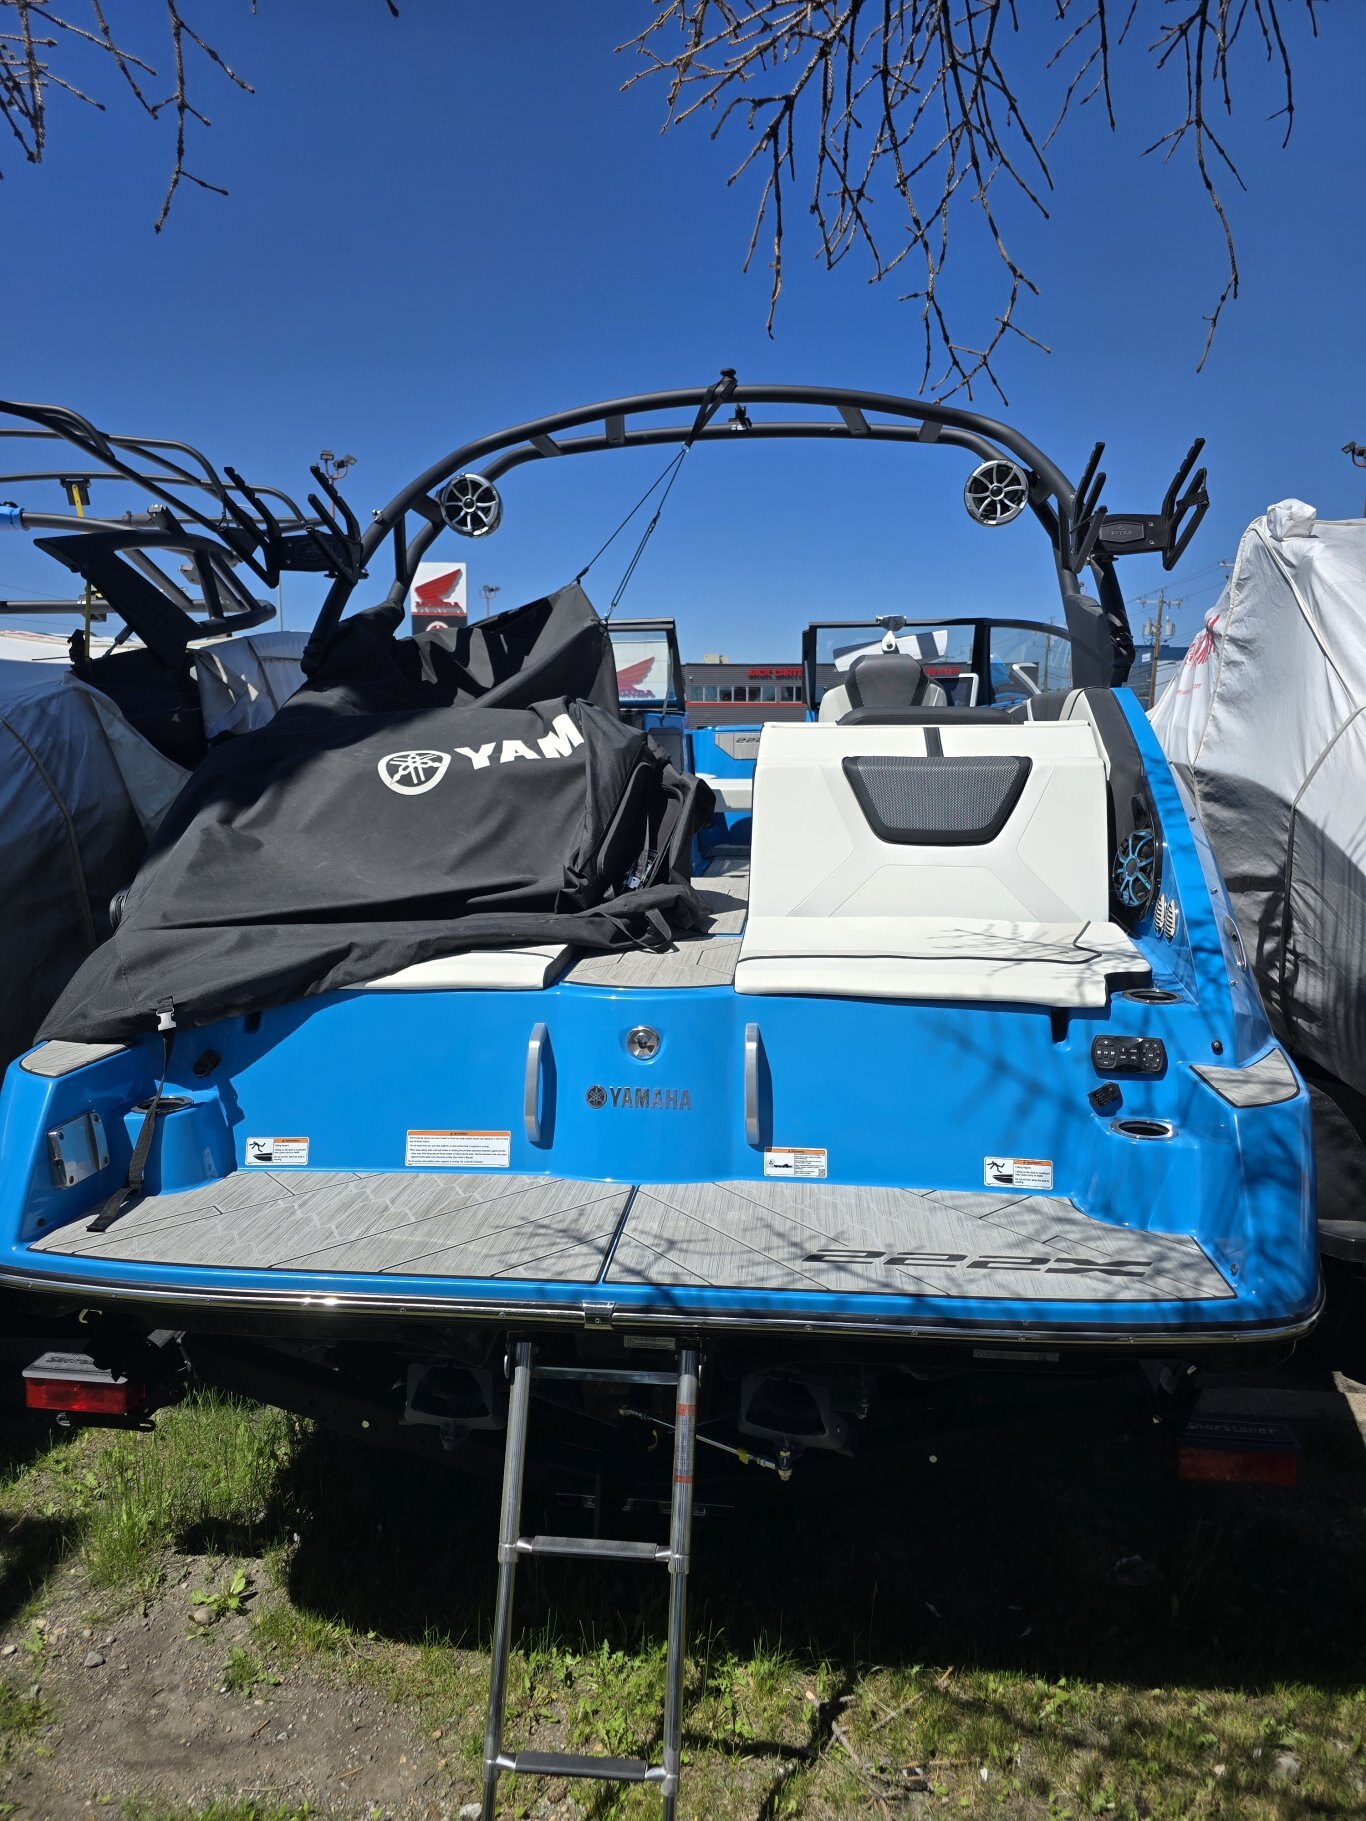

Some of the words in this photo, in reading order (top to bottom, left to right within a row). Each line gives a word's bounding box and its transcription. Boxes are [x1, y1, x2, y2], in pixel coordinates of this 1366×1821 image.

[453, 713, 585, 770] YAM
[609, 1086, 692, 1110] YAMAHA
[801, 1248, 1153, 1278] 222X
